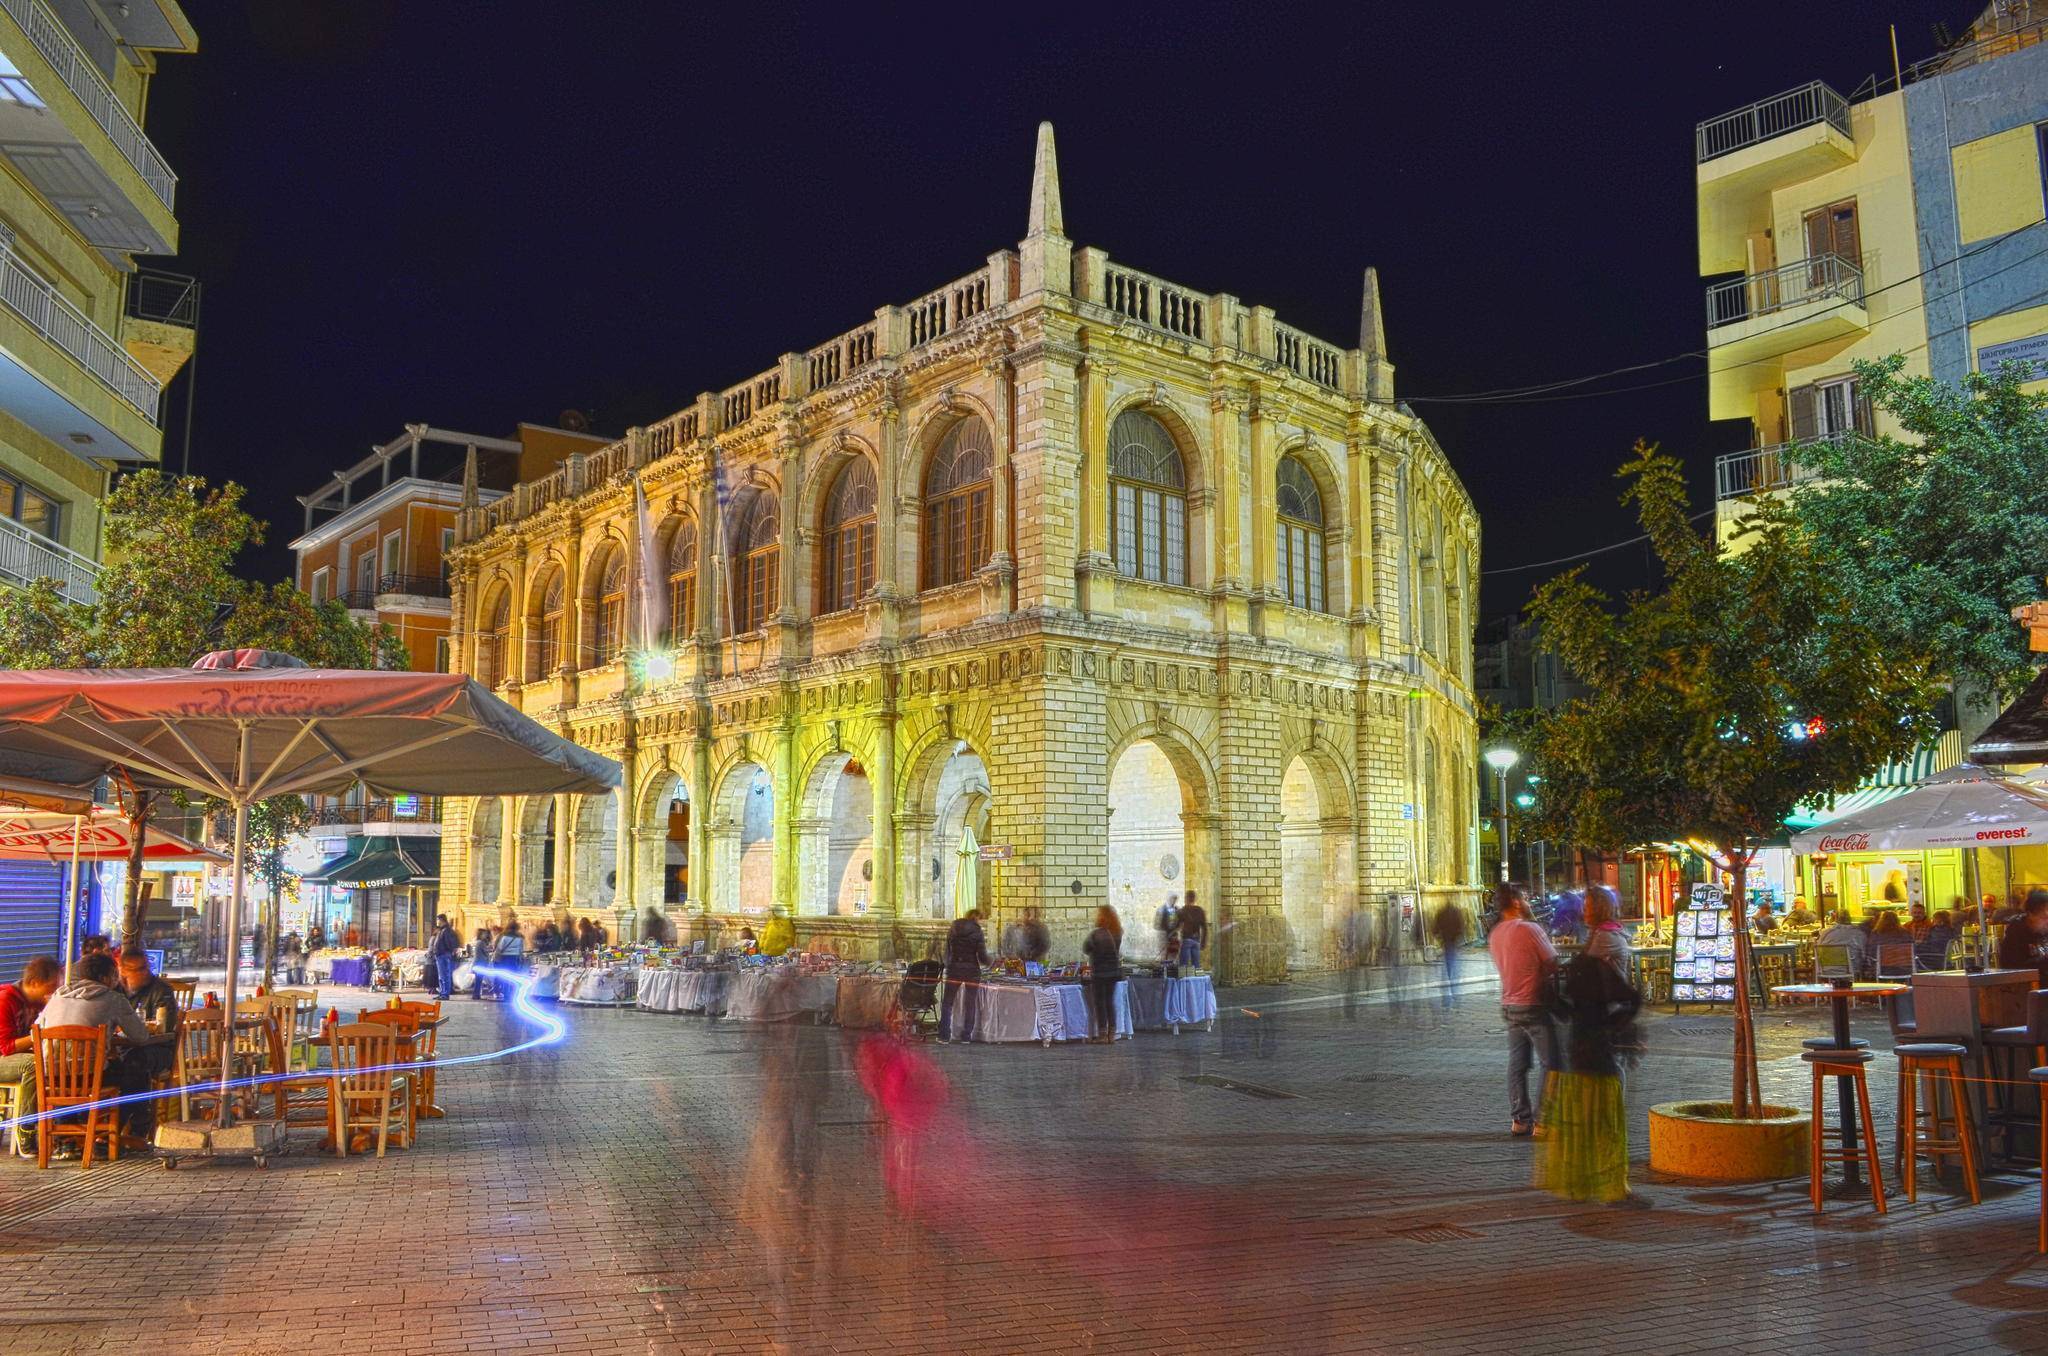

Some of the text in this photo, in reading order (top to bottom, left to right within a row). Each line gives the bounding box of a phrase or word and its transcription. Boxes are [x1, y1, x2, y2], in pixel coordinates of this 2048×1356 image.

[1976, 827, 2026, 841] everest
[1819, 833, 1871, 851] Coca-Cola
[366, 878, 393, 887] COFFEE
